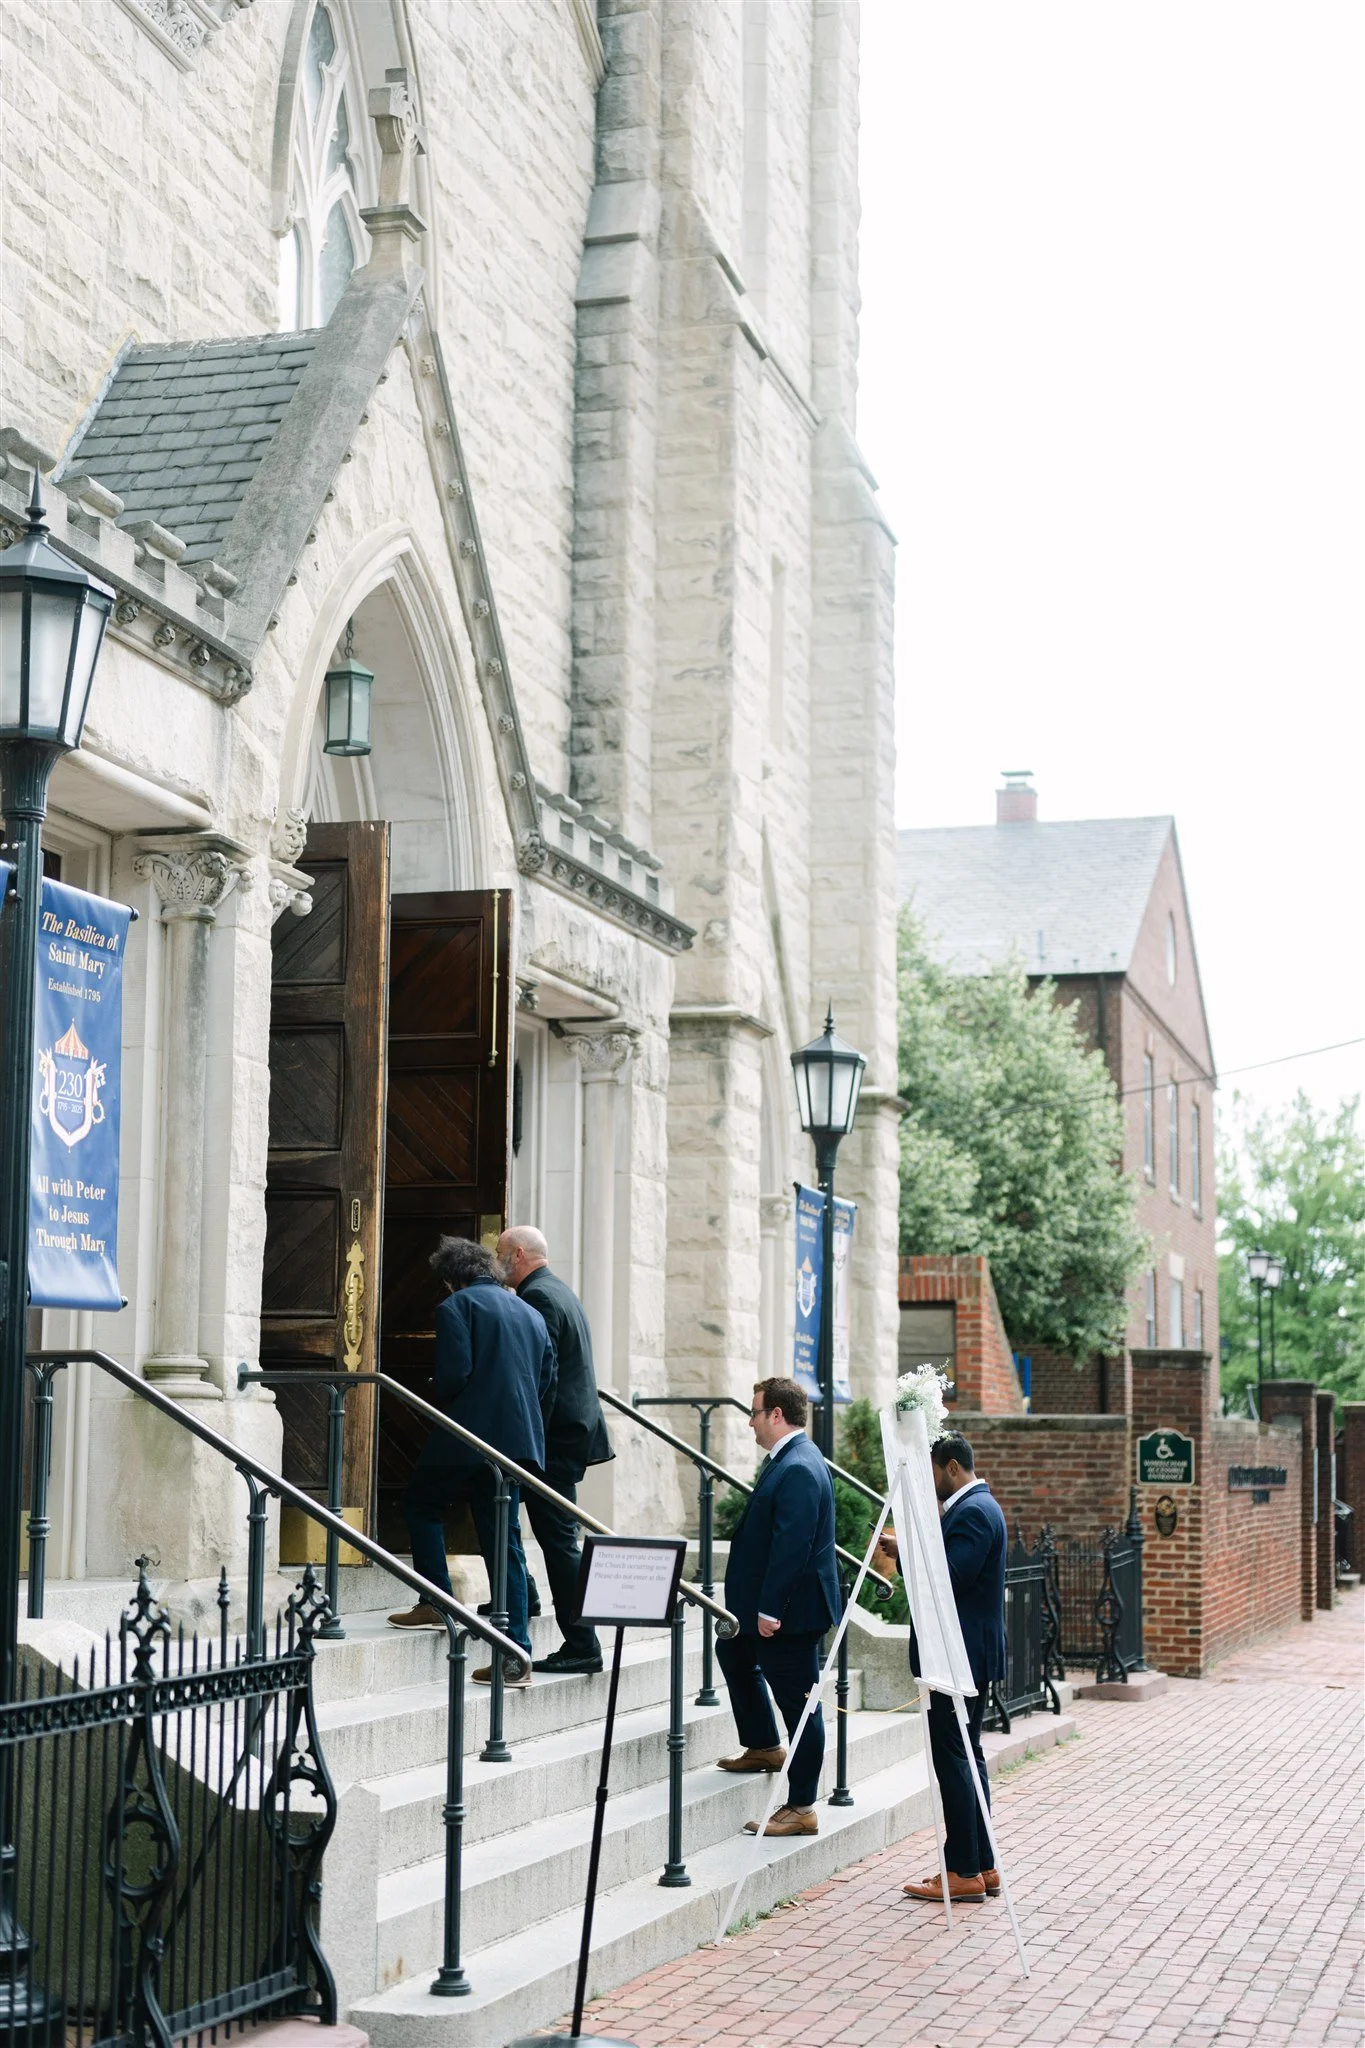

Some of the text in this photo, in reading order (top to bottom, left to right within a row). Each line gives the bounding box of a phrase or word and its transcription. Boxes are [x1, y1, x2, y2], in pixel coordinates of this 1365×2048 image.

[41, 911, 120, 951] The Basilica of
[48, 943, 106, 980] Saint Mary
[48, 978, 101, 1002] Established 1795
[58, 1070, 83, 1098] 230
[36, 1174, 106, 1201] All with Peter
[48, 1206, 89, 1225] to Jesus
[35, 1228, 106, 1256] Through Mary
[594, 1572, 612, 1580] Please
[604, 1561, 626, 1570] Church
